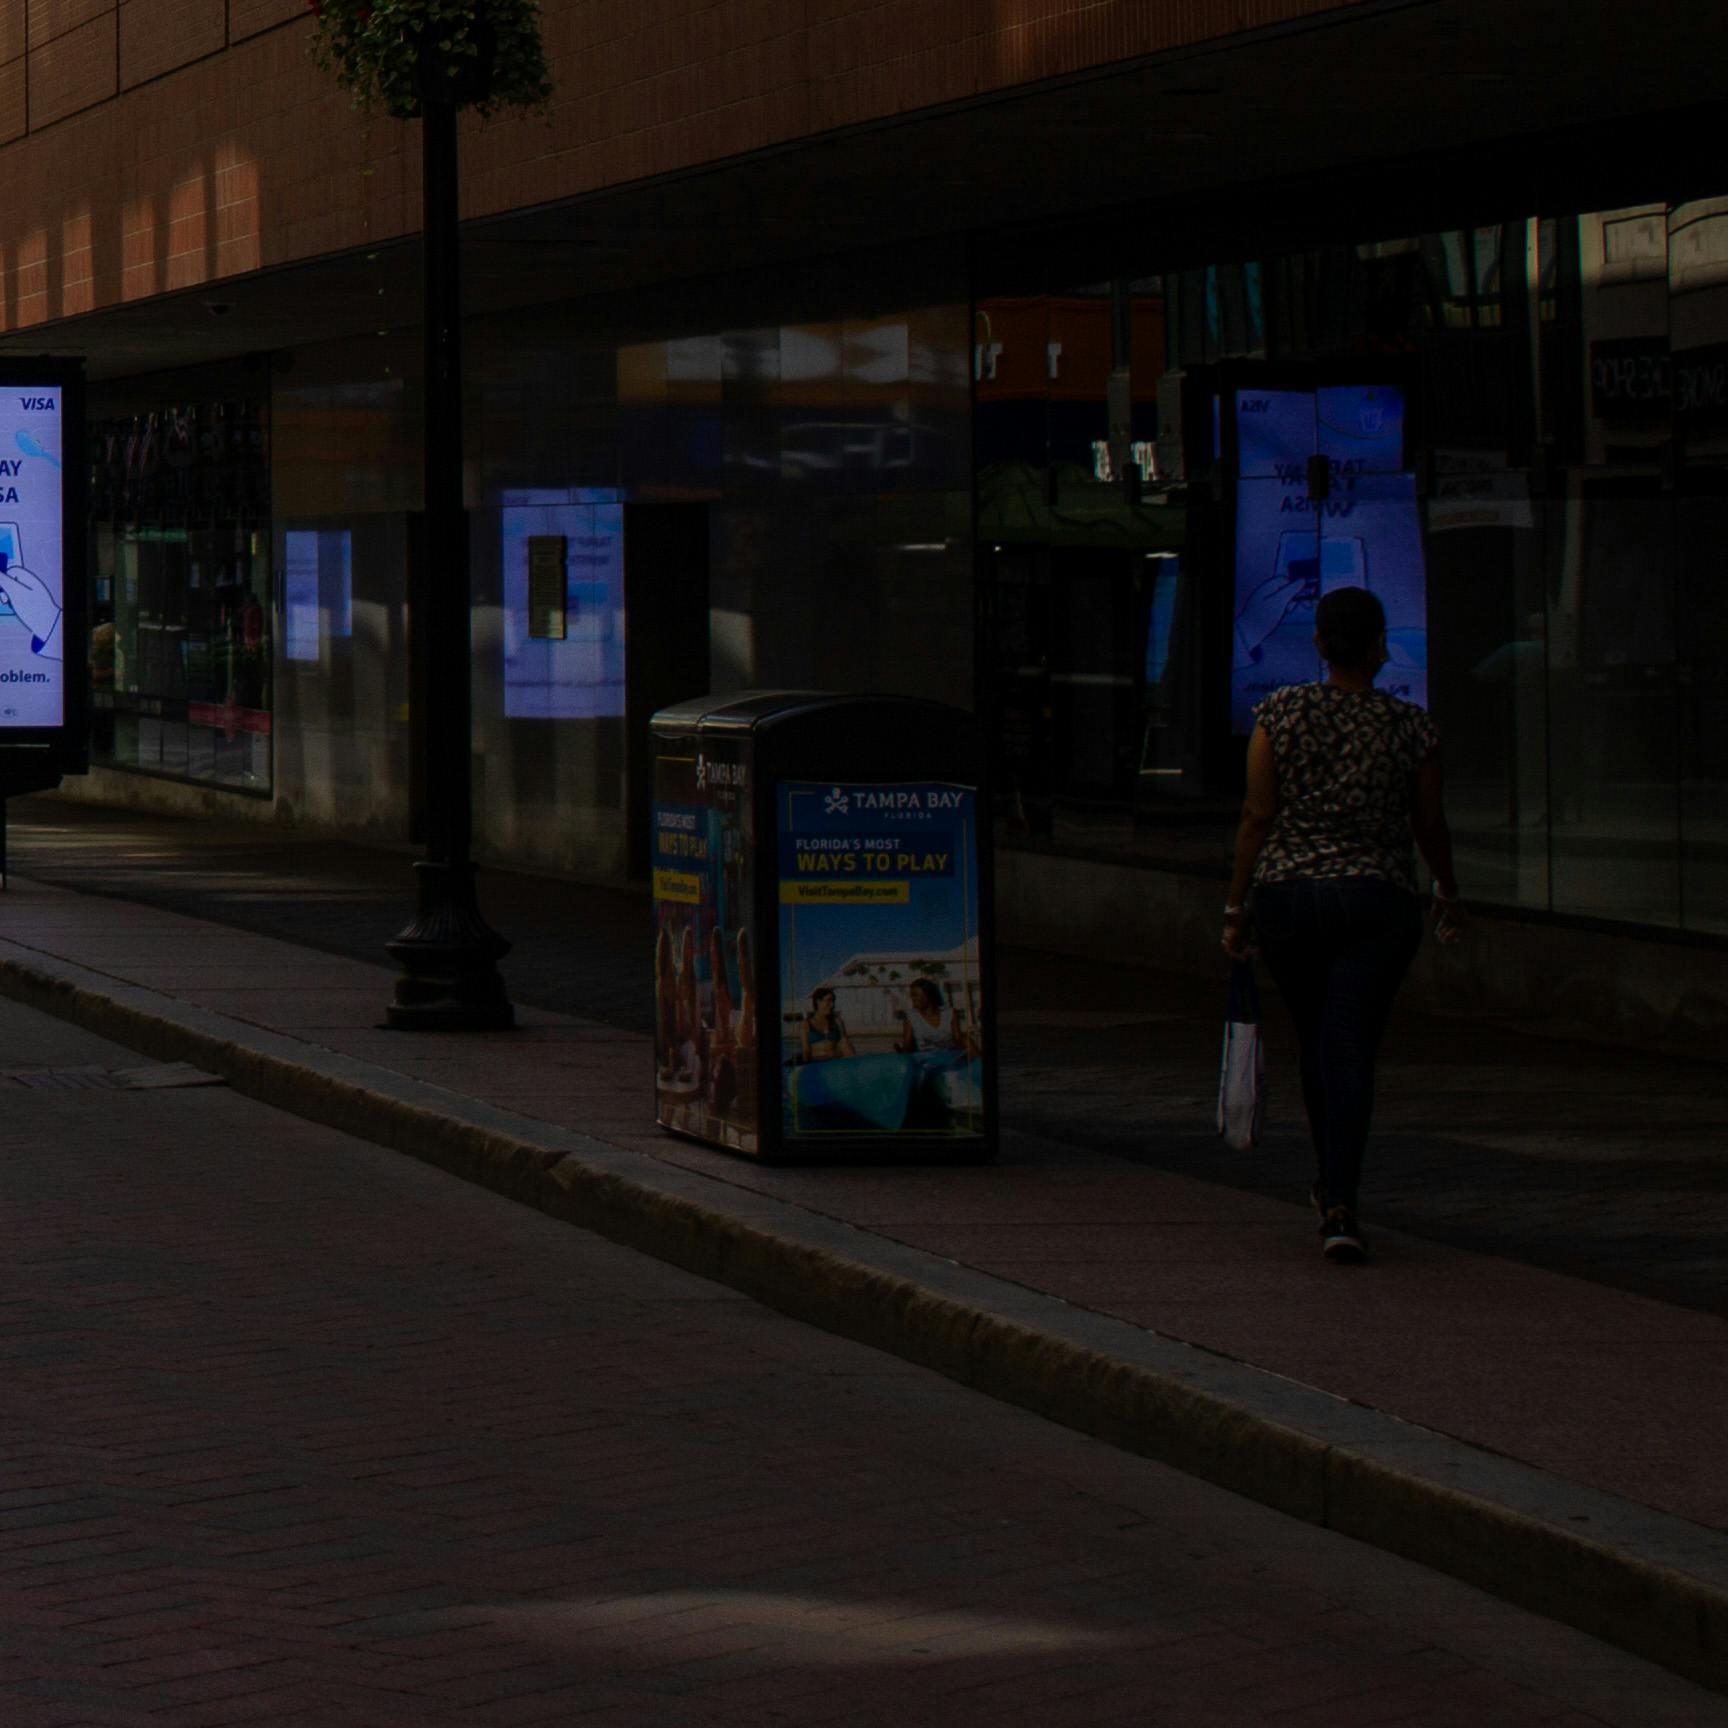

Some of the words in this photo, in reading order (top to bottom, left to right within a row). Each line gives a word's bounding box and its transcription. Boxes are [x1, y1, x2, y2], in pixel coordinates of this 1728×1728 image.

[19, 397, 55, 411] VISA
[705, 761, 732, 785] TAMPA
[852, 792, 921, 809] TAMPA
[927, 791, 963, 809] BAY
[883, 811, 933, 820] FLORIDA
[795, 838, 861, 851] FLORIDA'S
[864, 838, 901, 850] MOST
[796, 853, 857, 872] WAYS
[863, 853, 891, 872] TO
[896, 853, 949, 872] PLAY
[798, 886, 898, 899] VisitTampaBay.com
